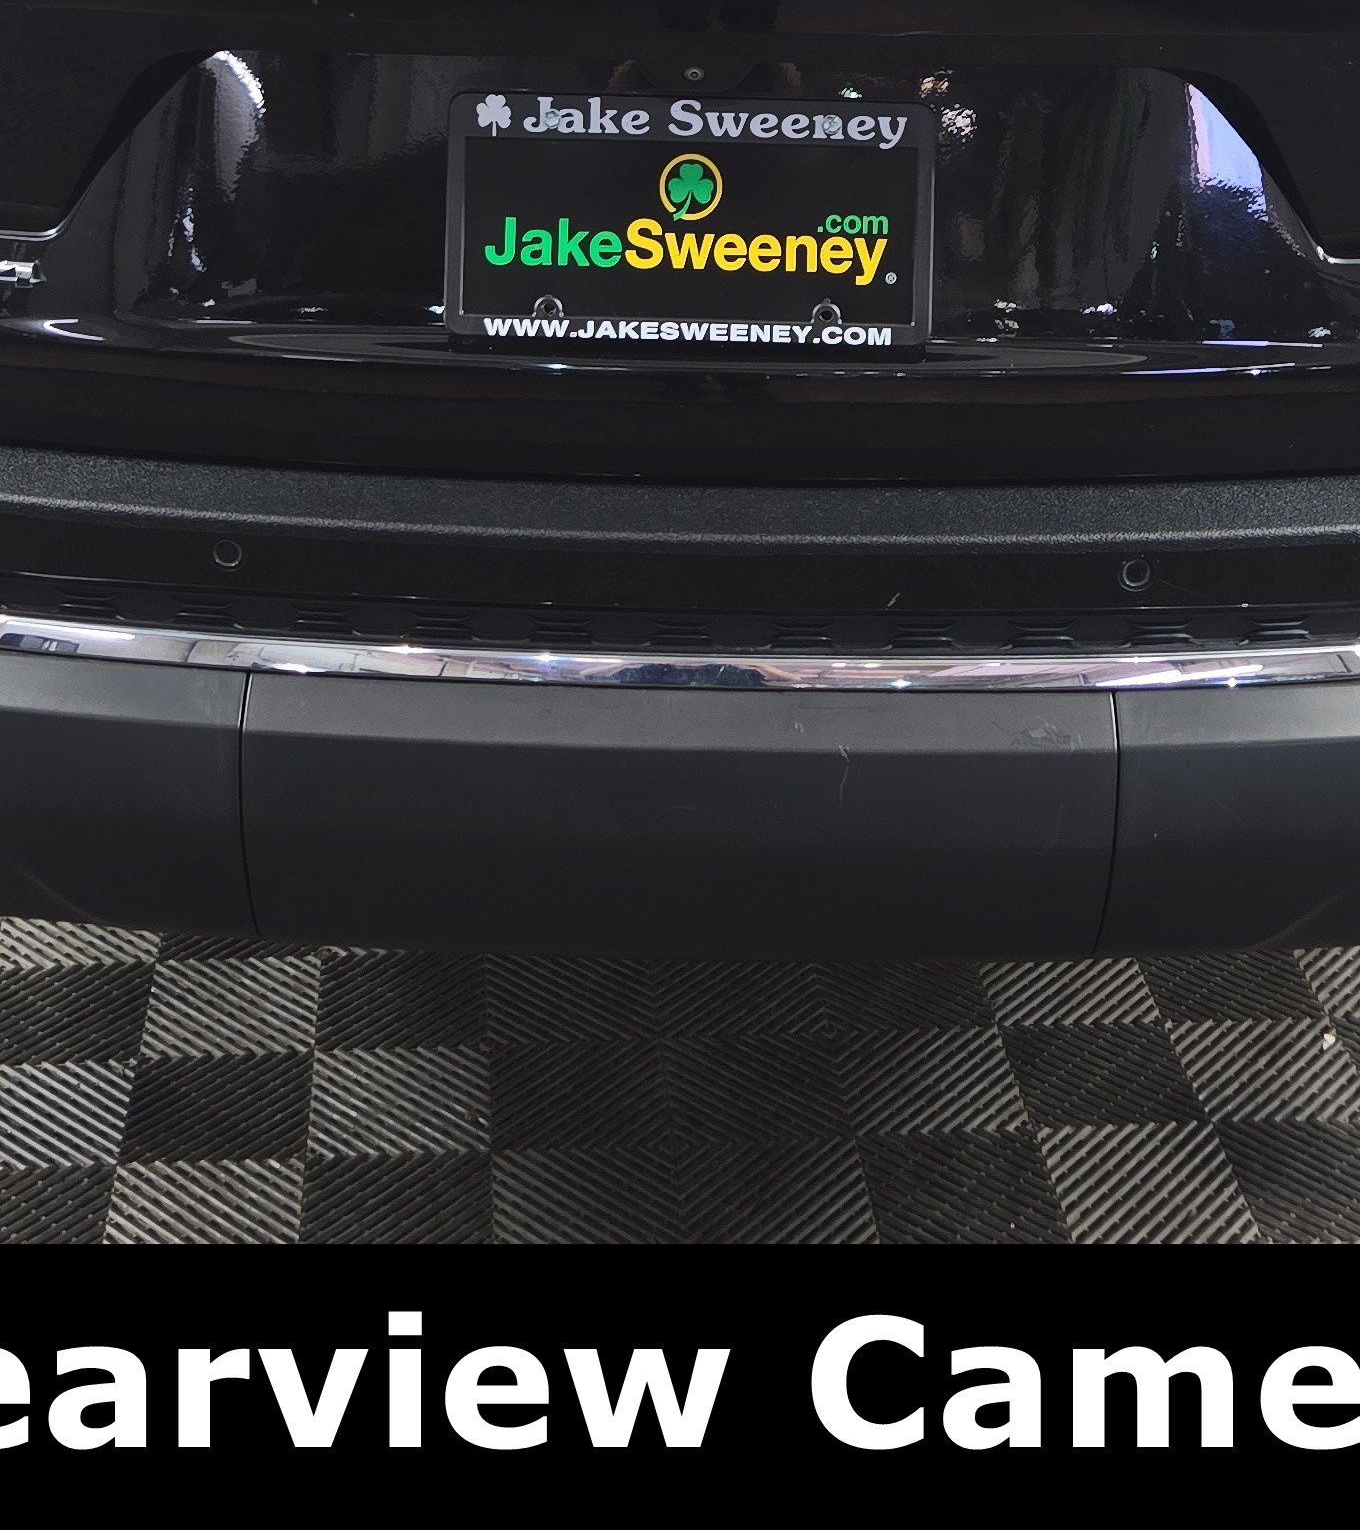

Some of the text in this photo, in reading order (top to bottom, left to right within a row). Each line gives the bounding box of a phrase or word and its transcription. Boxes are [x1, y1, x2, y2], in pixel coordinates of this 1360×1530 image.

[522, 96, 909, 150] Jake Sweeney
[484, 216, 889, 285] JakeSweeney
[483, 317, 893, 346] WWW.JAKESWEENEY.COM
